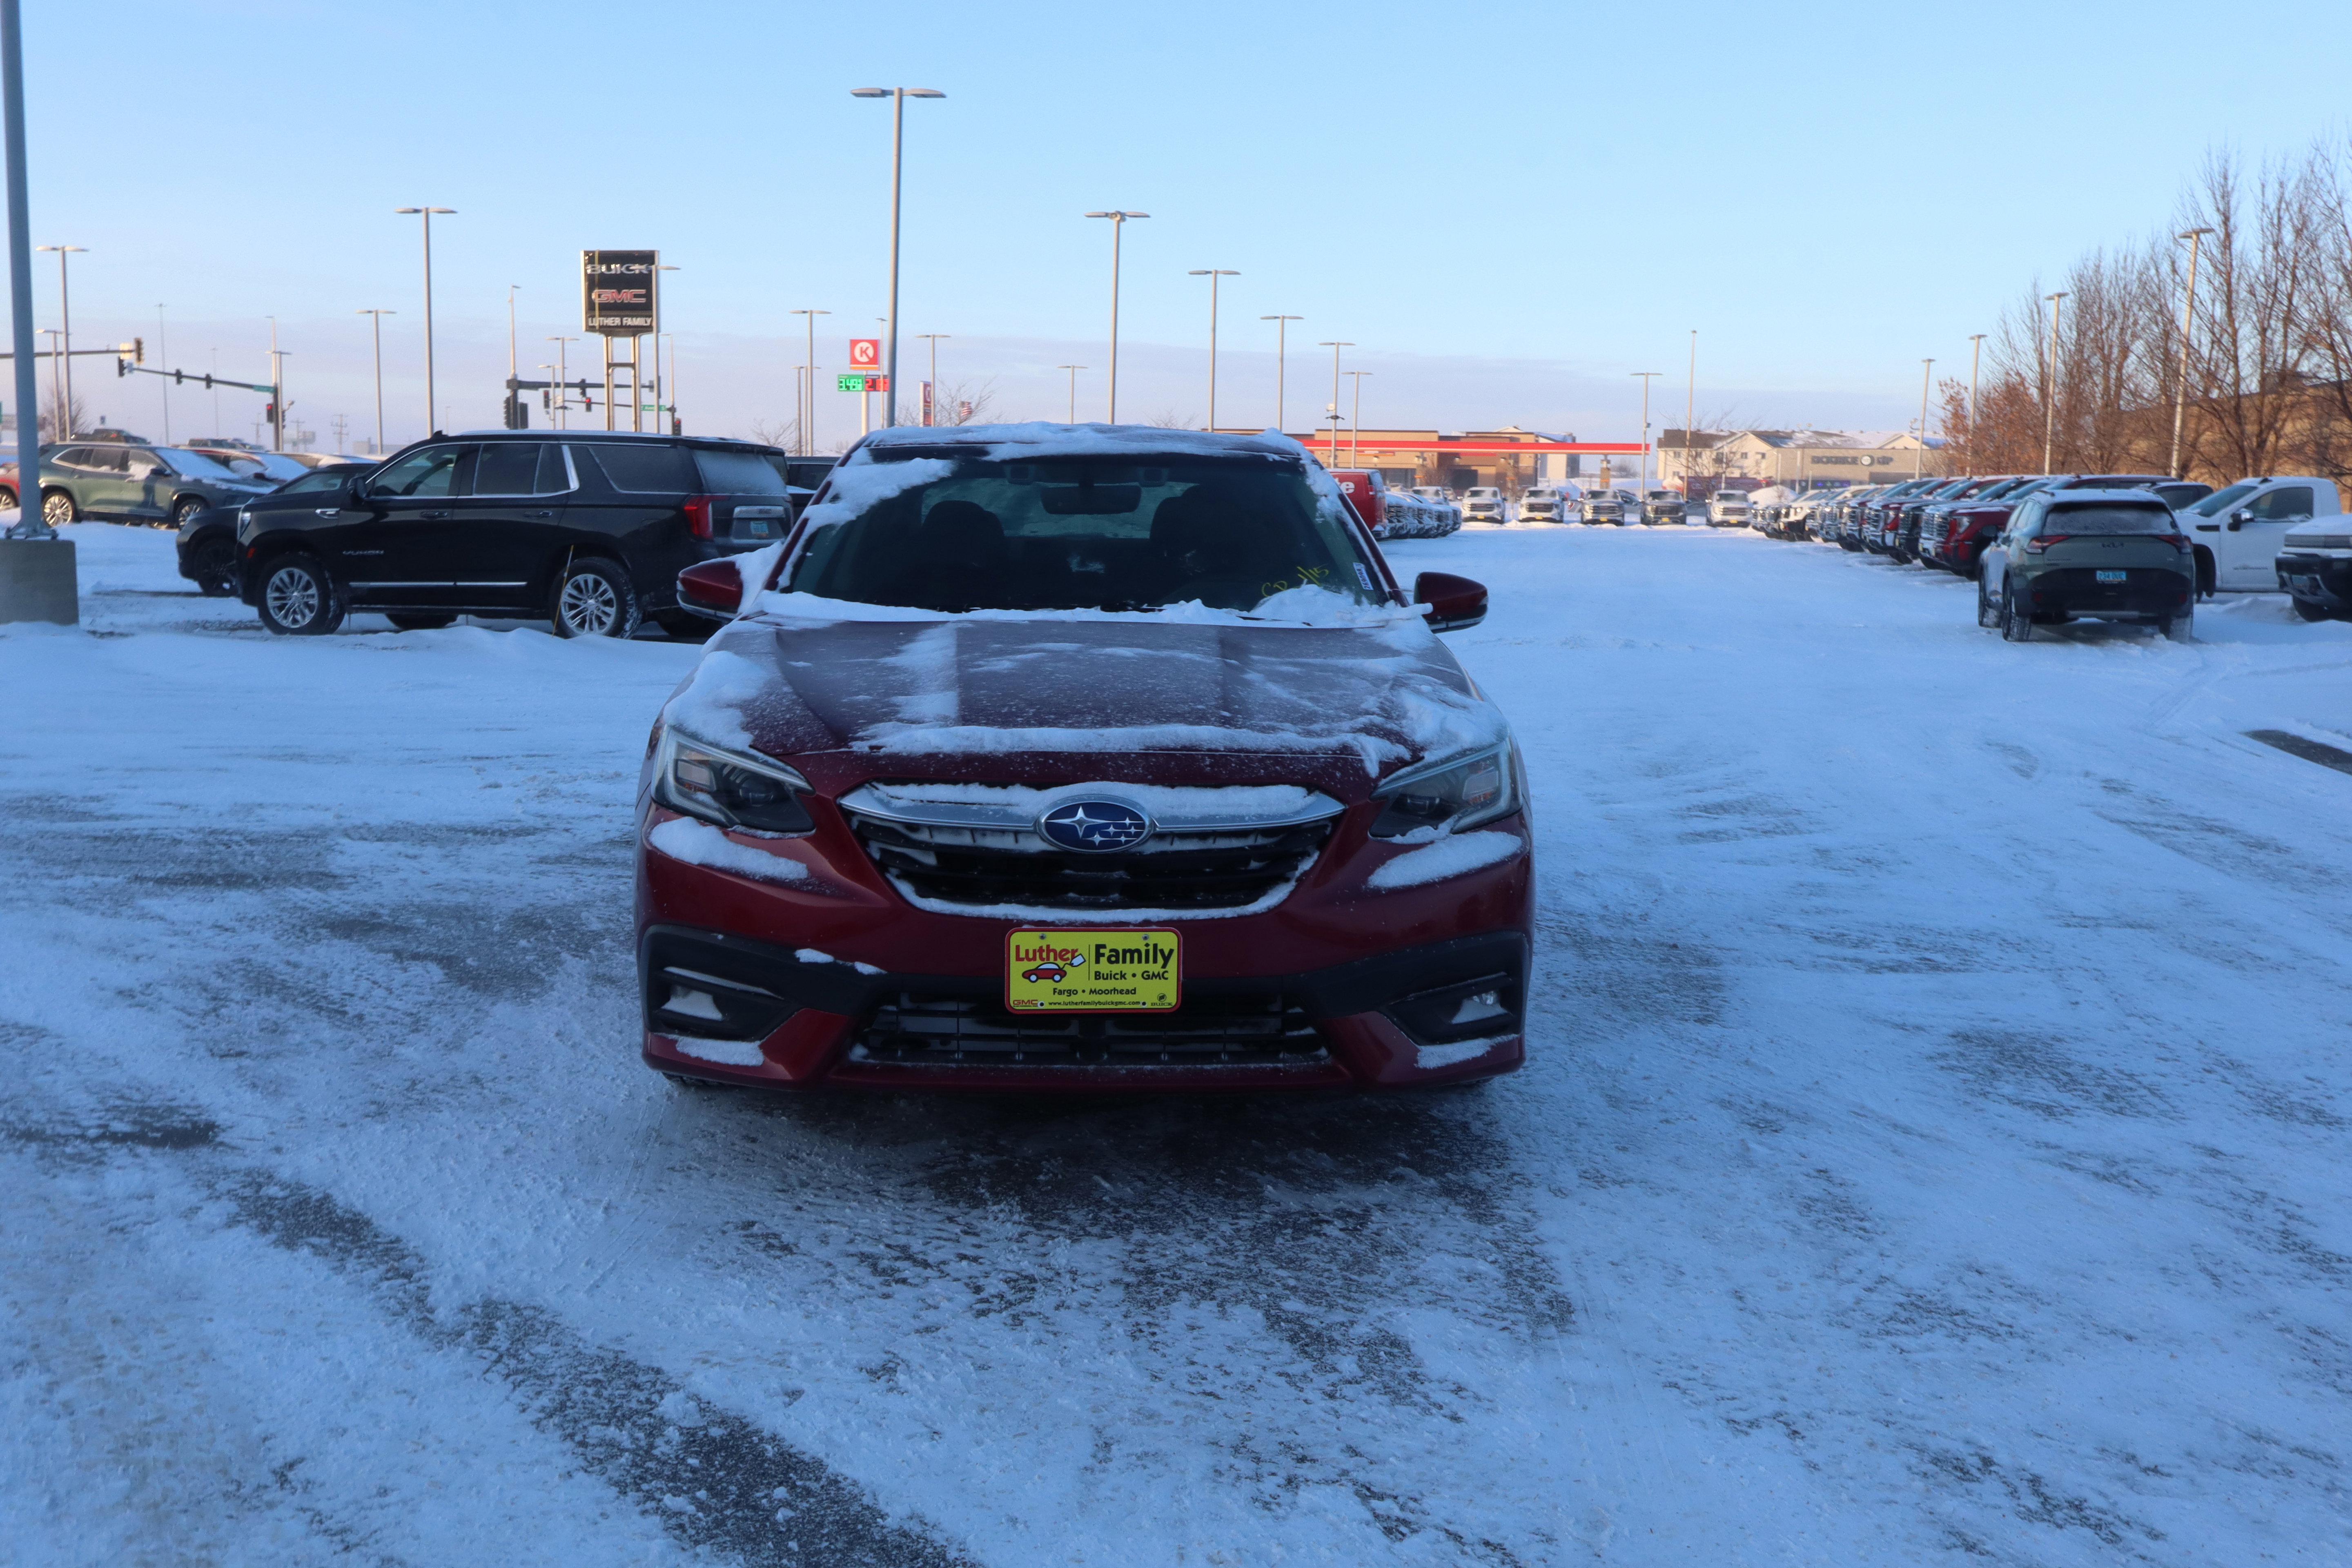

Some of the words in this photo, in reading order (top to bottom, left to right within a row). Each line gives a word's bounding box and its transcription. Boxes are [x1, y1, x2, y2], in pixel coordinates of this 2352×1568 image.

[586, 264, 649, 274] BUICK
[592, 289, 646, 303] GMC
[588, 317, 621, 326] LUTHER
[622, 317, 652, 326] FAMILY
[1015, 944, 1079, 962] Luther
[1095, 942, 1174, 969] Family
[1094, 971, 1127, 980] Buick
[1141, 971, 1169, 980] GMC
[1053, 988, 1078, 997] Fargo
